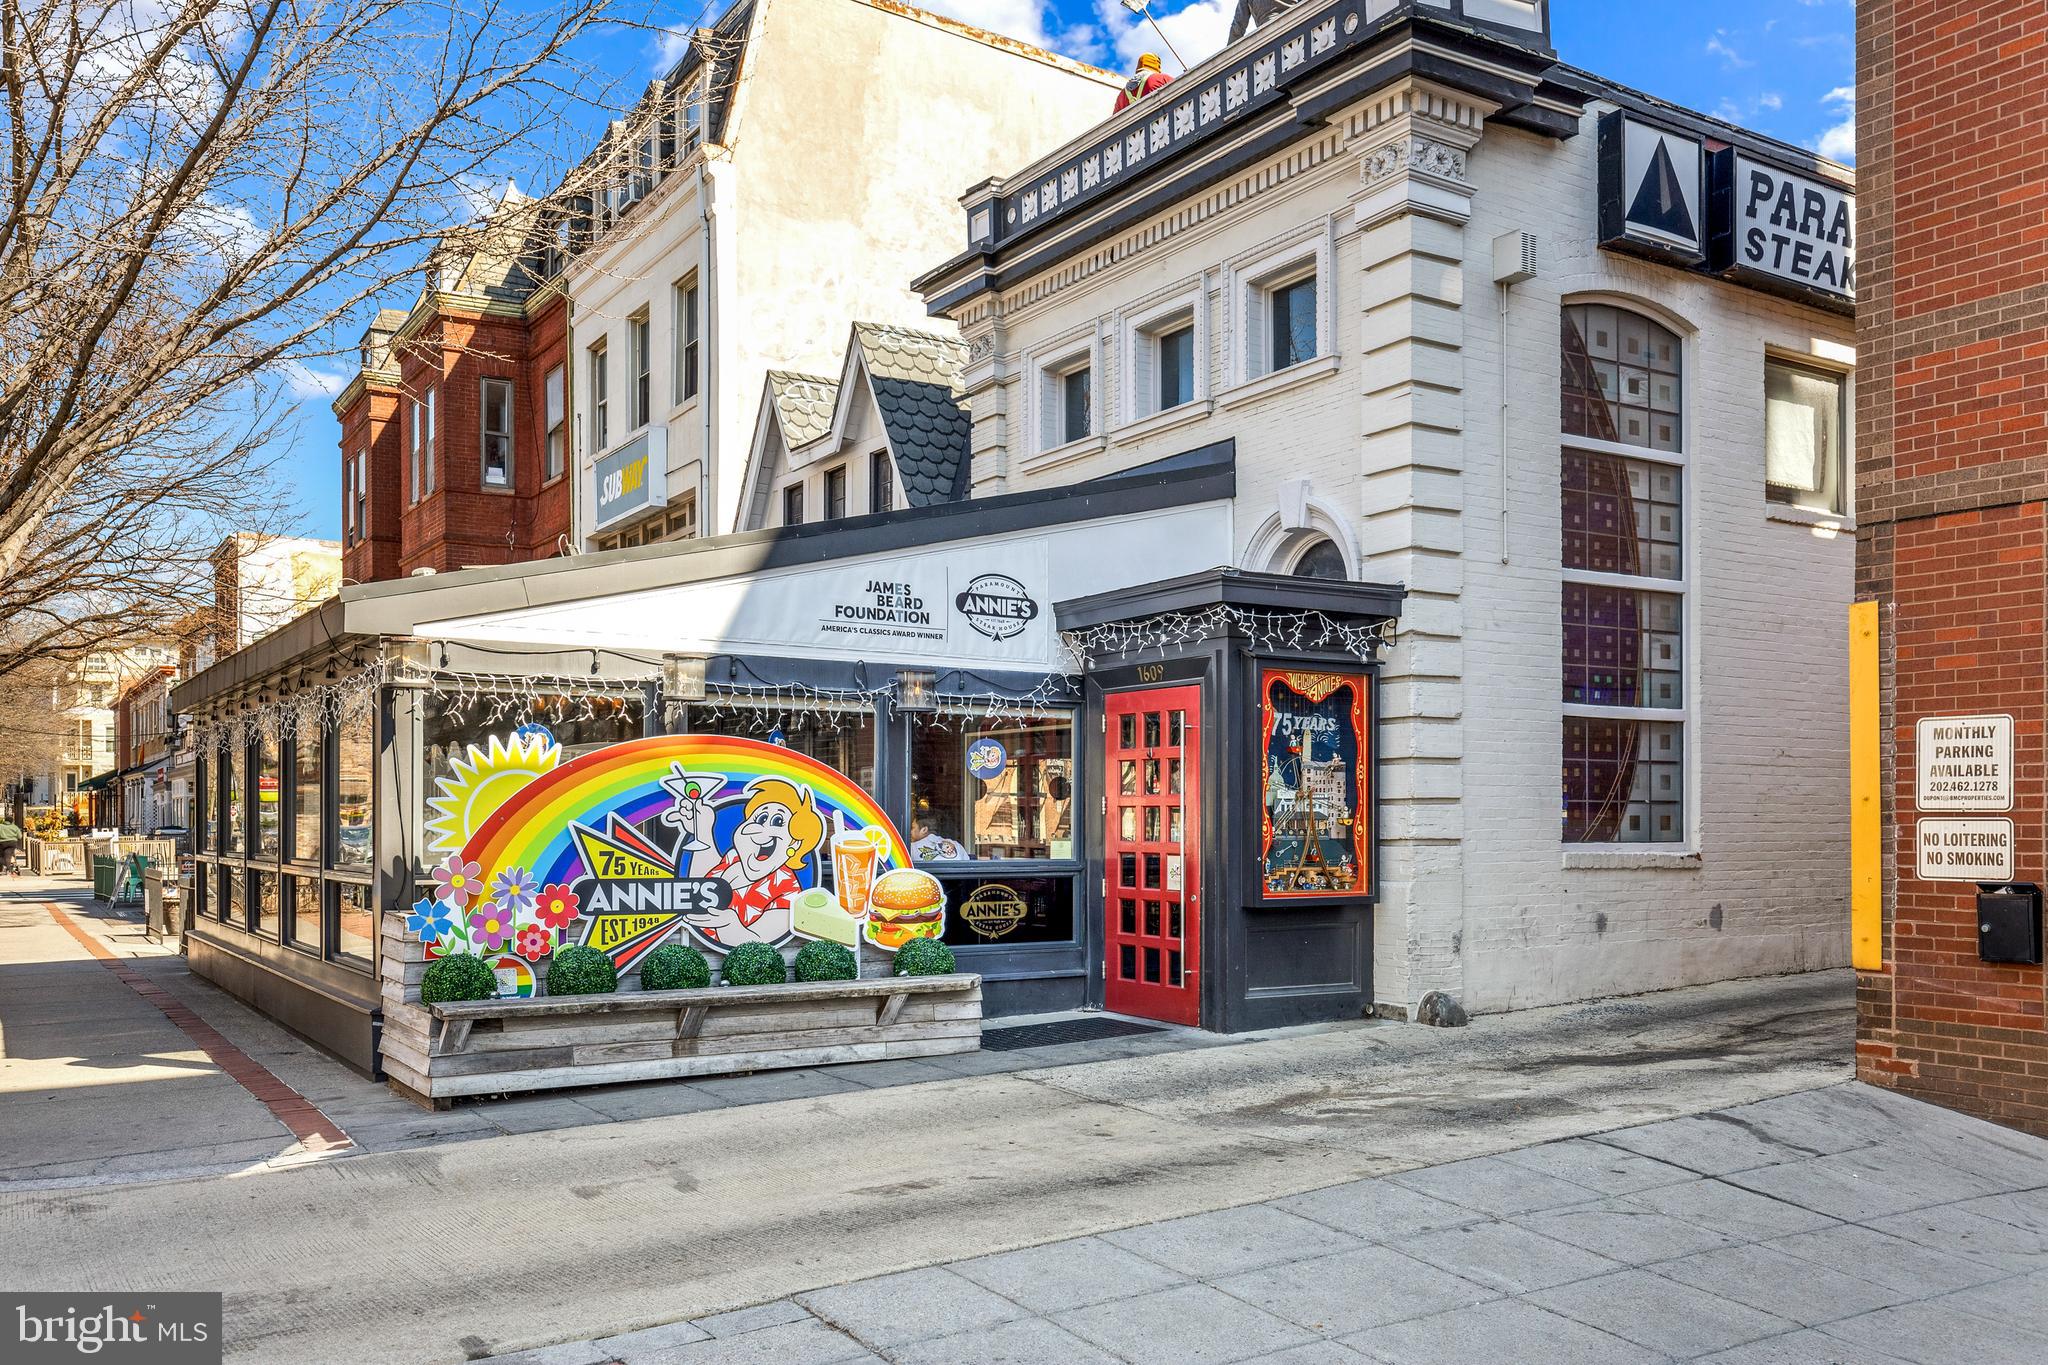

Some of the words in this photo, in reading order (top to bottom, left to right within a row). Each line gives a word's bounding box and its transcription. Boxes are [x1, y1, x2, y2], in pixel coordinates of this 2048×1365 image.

[1745, 227, 1855, 291] STEAK
[600, 455, 649, 507] SUBWAY
[866, 580, 911, 596] JAMES
[877, 595, 923, 610] BEARD
[962, 594, 1032, 618] ANNIE'S
[835, 605, 930, 624] FOUNDATION
[821, 624, 858, 634] AMERICA'S
[859, 627, 891, 636] CLASSICS
[892, 630, 916, 638] AWARD
[917, 632, 944, 640] WINNER
[1137, 664, 1164, 682] 1609
[1271, 712, 1293, 735] 75
[1293, 716, 1337, 731] YEARS
[1933, 725, 1996, 740] MONTHLY
[1935, 745, 1994, 759] PARKING
[1930, 764, 1999, 777] AVAILABLE
[1930, 781, 1999, 792] 202.462.1278
[1923, 832, 1940, 847] NO
[1943, 833, 2007, 847] LOITERING
[598, 850, 626, 876] 75
[629, 861, 660, 876] YEARS
[1926, 851, 1943, 865] NO
[1947, 852, 2004, 866] SMOKING
[585, 881, 720, 912] ANNIE'S
[966, 903, 1021, 918] ANNIE'S
